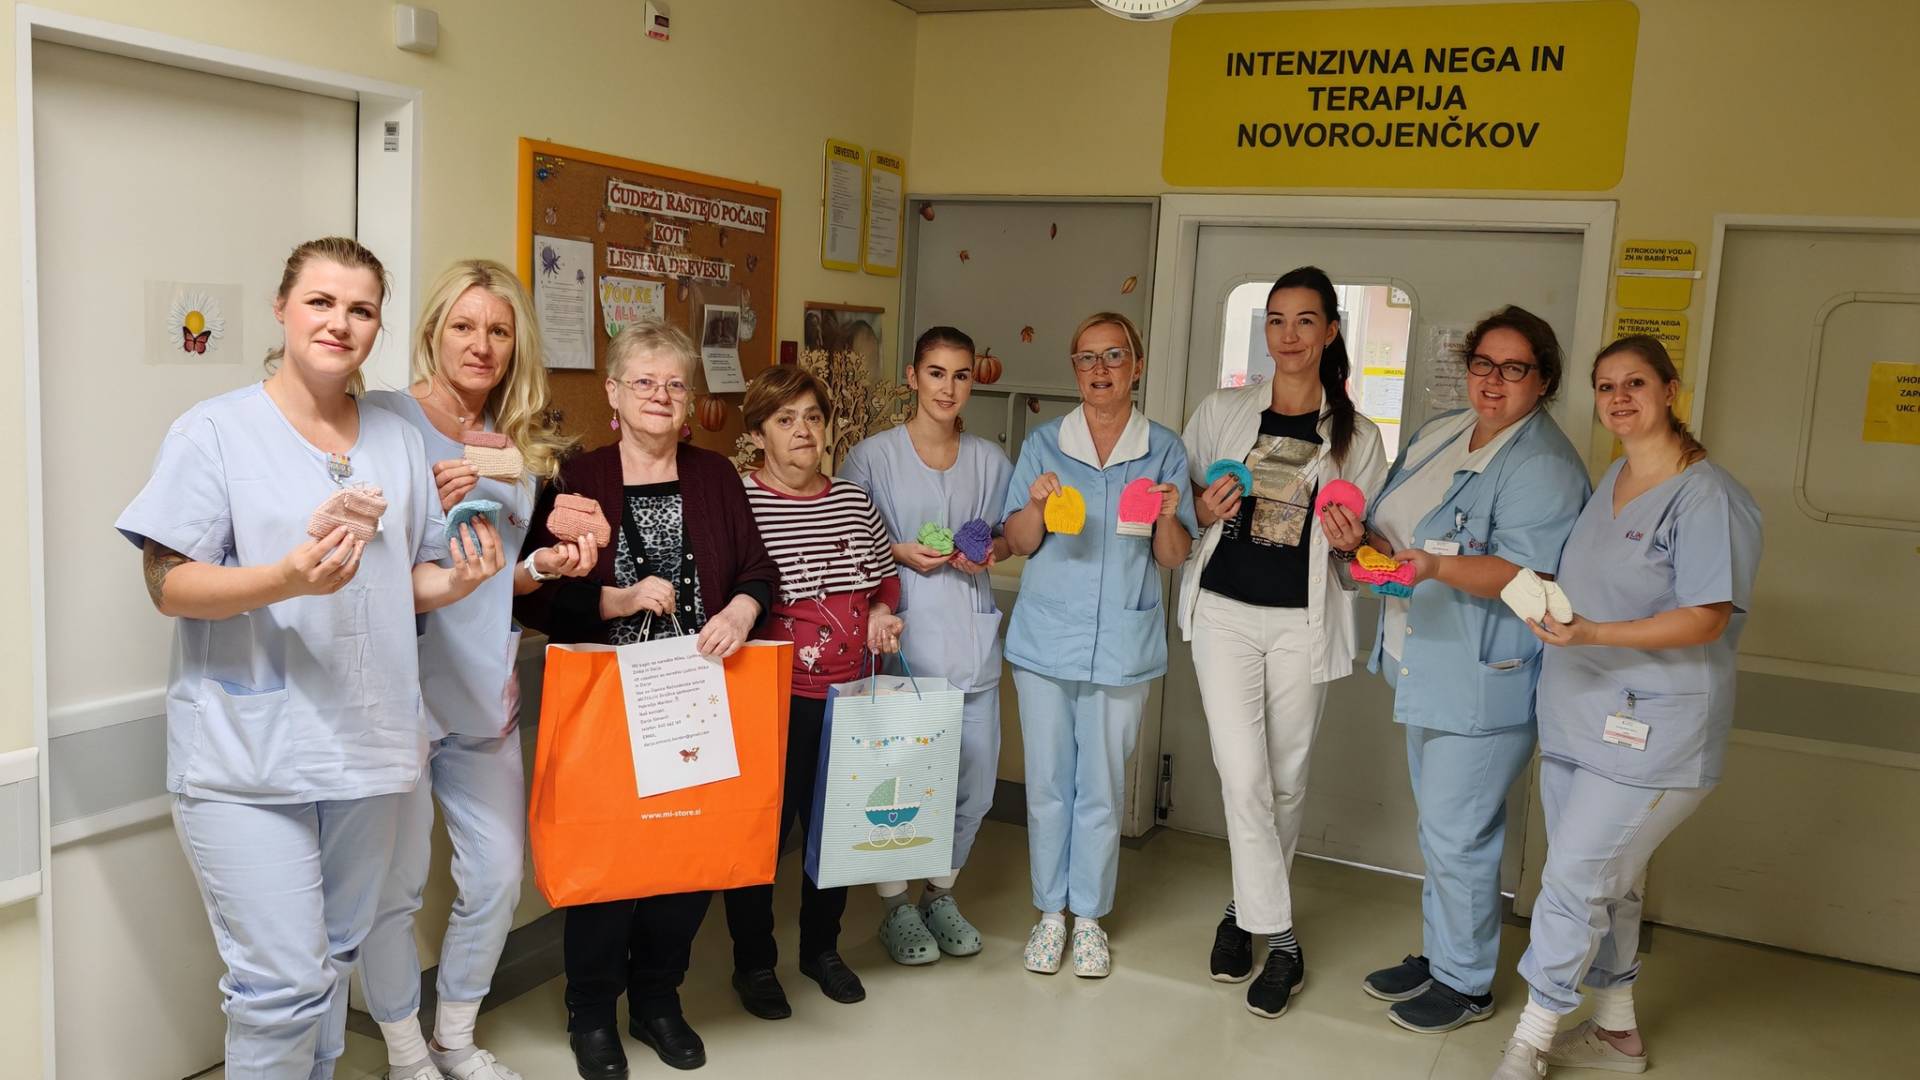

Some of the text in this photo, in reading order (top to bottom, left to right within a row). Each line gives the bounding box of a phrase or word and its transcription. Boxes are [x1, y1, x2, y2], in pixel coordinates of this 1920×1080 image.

[1226, 45, 1564, 76] INTENZIVNA NEGA IN
[1308, 85, 1467, 111] TERAPIJA
[1237, 115, 1539, 148] NOVOROJENČKOV
[666, 194, 720, 221] RASTEJO
[655, 225, 681, 244] KOT
[609, 251, 644, 270] LISTI
[648, 254, 667, 273] NA
[1900, 389, 1920, 398] ZAP
[641, 808, 702, 820] www.mi-store.si
